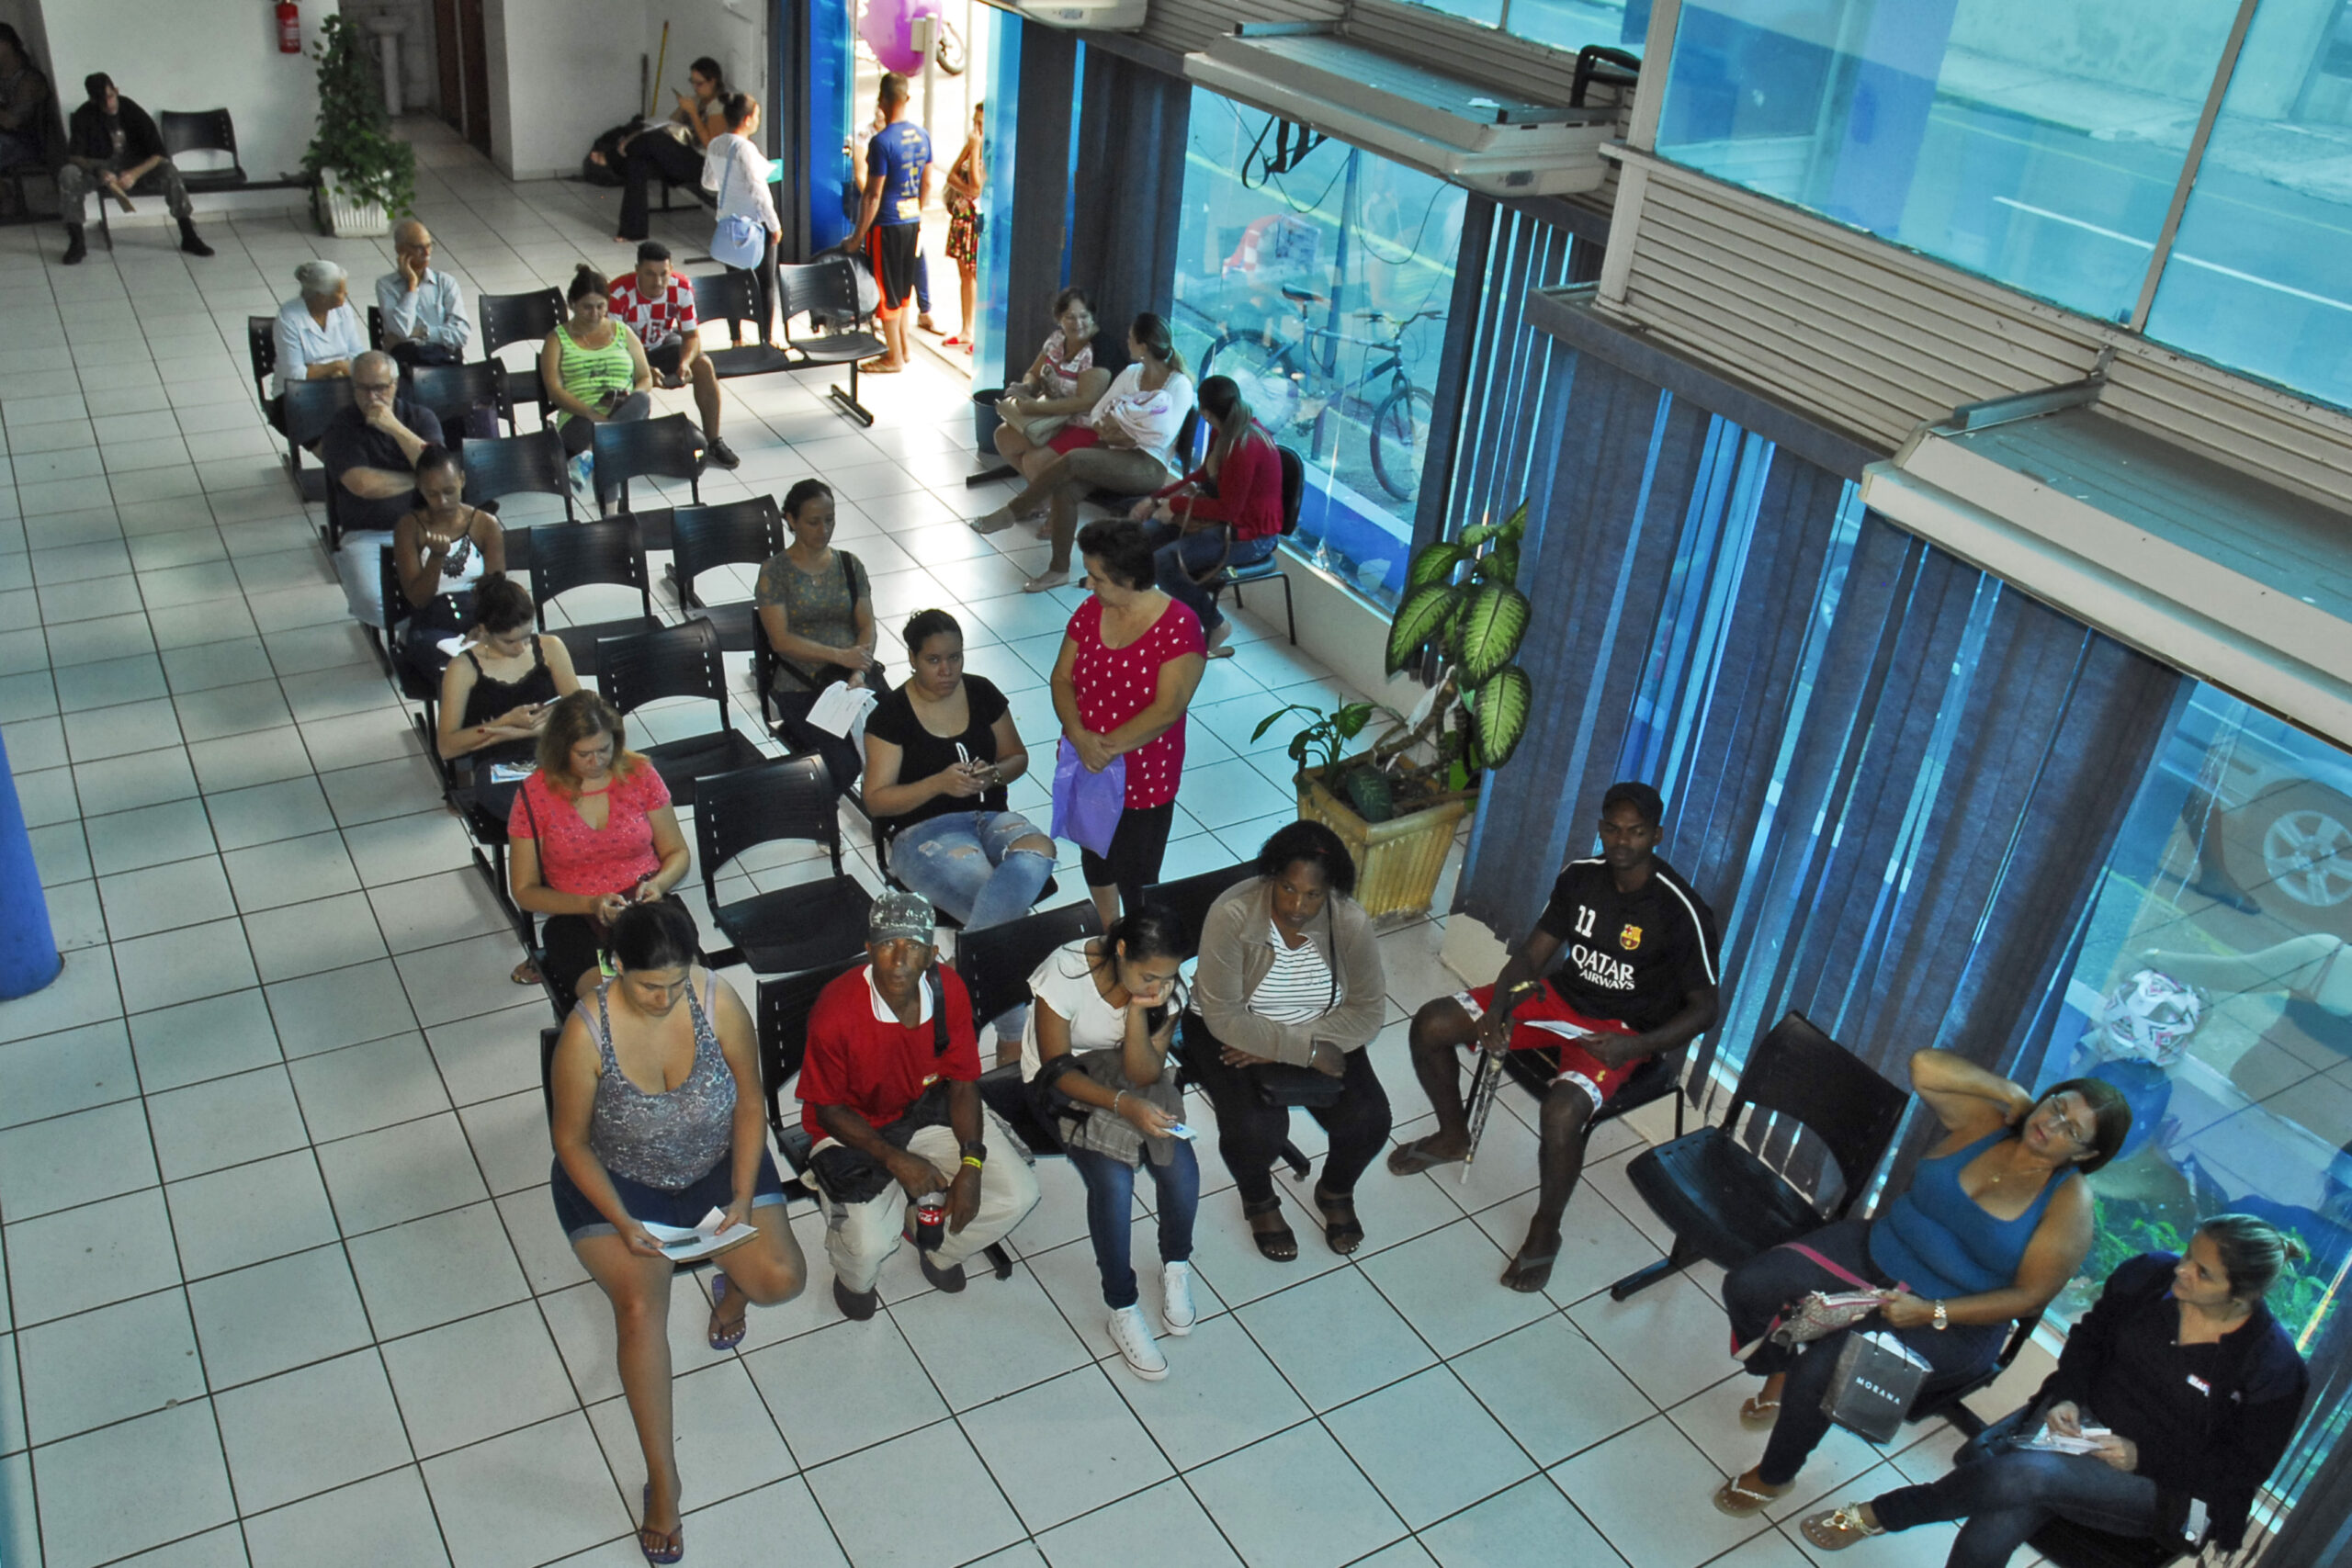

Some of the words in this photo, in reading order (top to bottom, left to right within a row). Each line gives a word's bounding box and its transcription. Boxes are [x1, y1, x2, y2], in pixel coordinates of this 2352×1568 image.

[1575, 905, 1596, 938] 11
[1571, 944, 1634, 981] QATAR
[1580, 969, 1634, 990] AIRWAYS
[1856, 1376, 1901, 1405] MORANA
